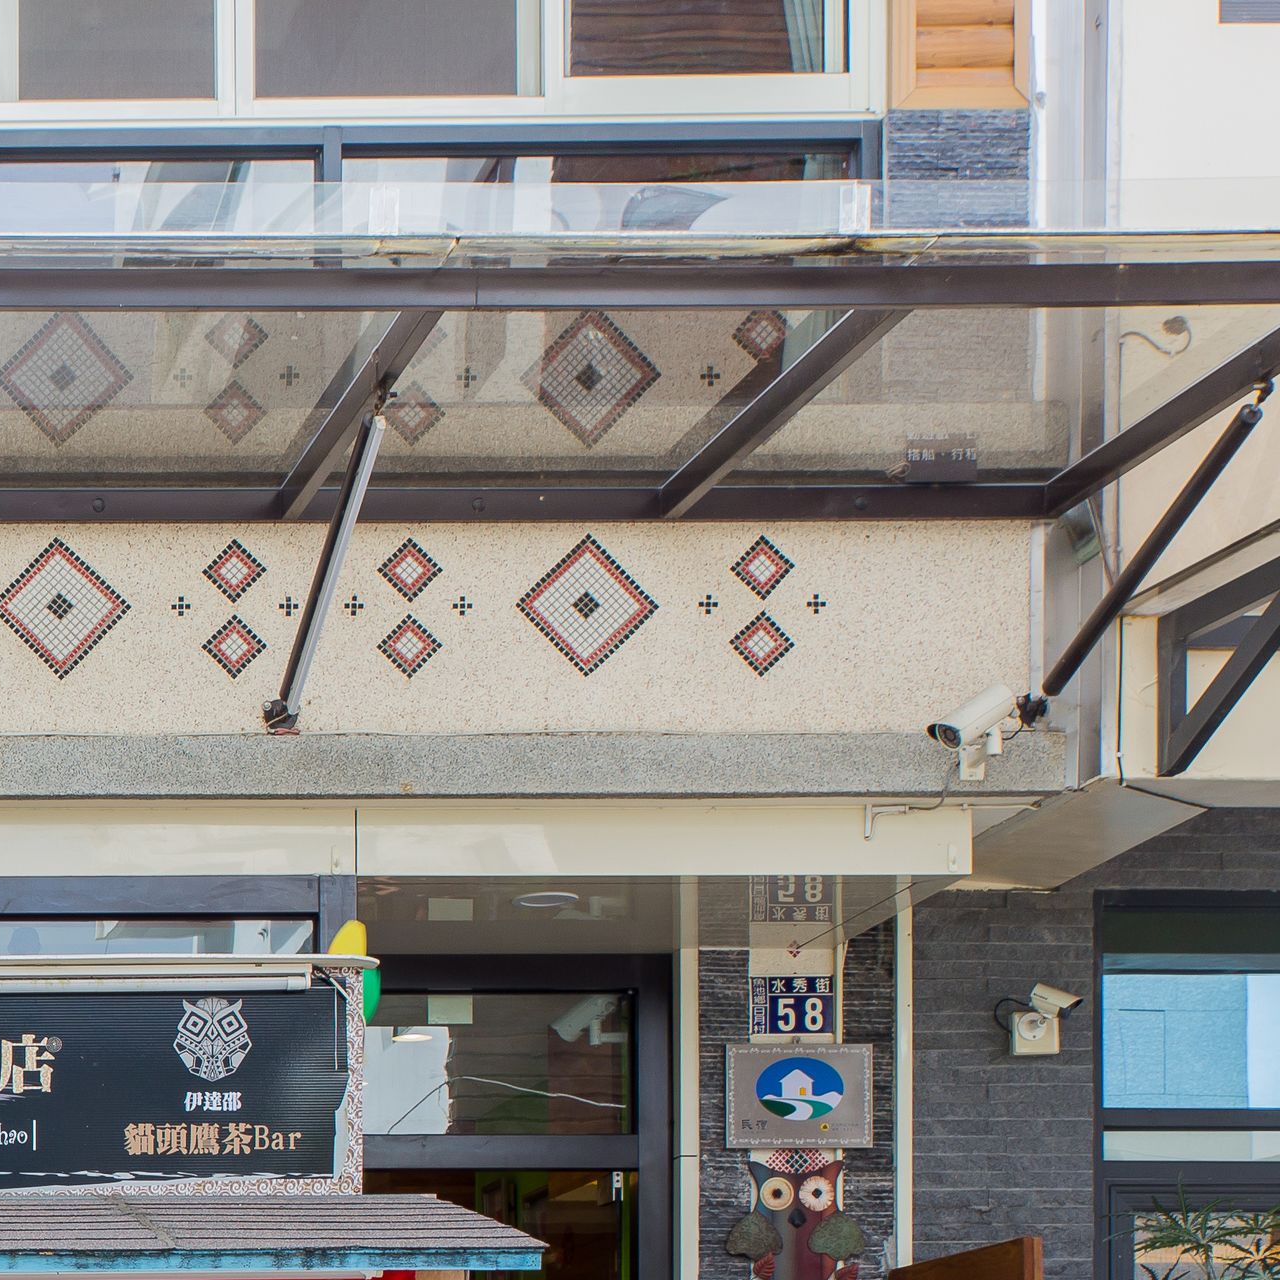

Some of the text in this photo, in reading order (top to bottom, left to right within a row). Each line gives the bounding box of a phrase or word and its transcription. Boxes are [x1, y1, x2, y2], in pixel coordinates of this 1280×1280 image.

[771, 978, 831, 993] 水秀街
[777, 997, 824, 1031] 58
[184, 1091, 242, 1112] 伊達邵
